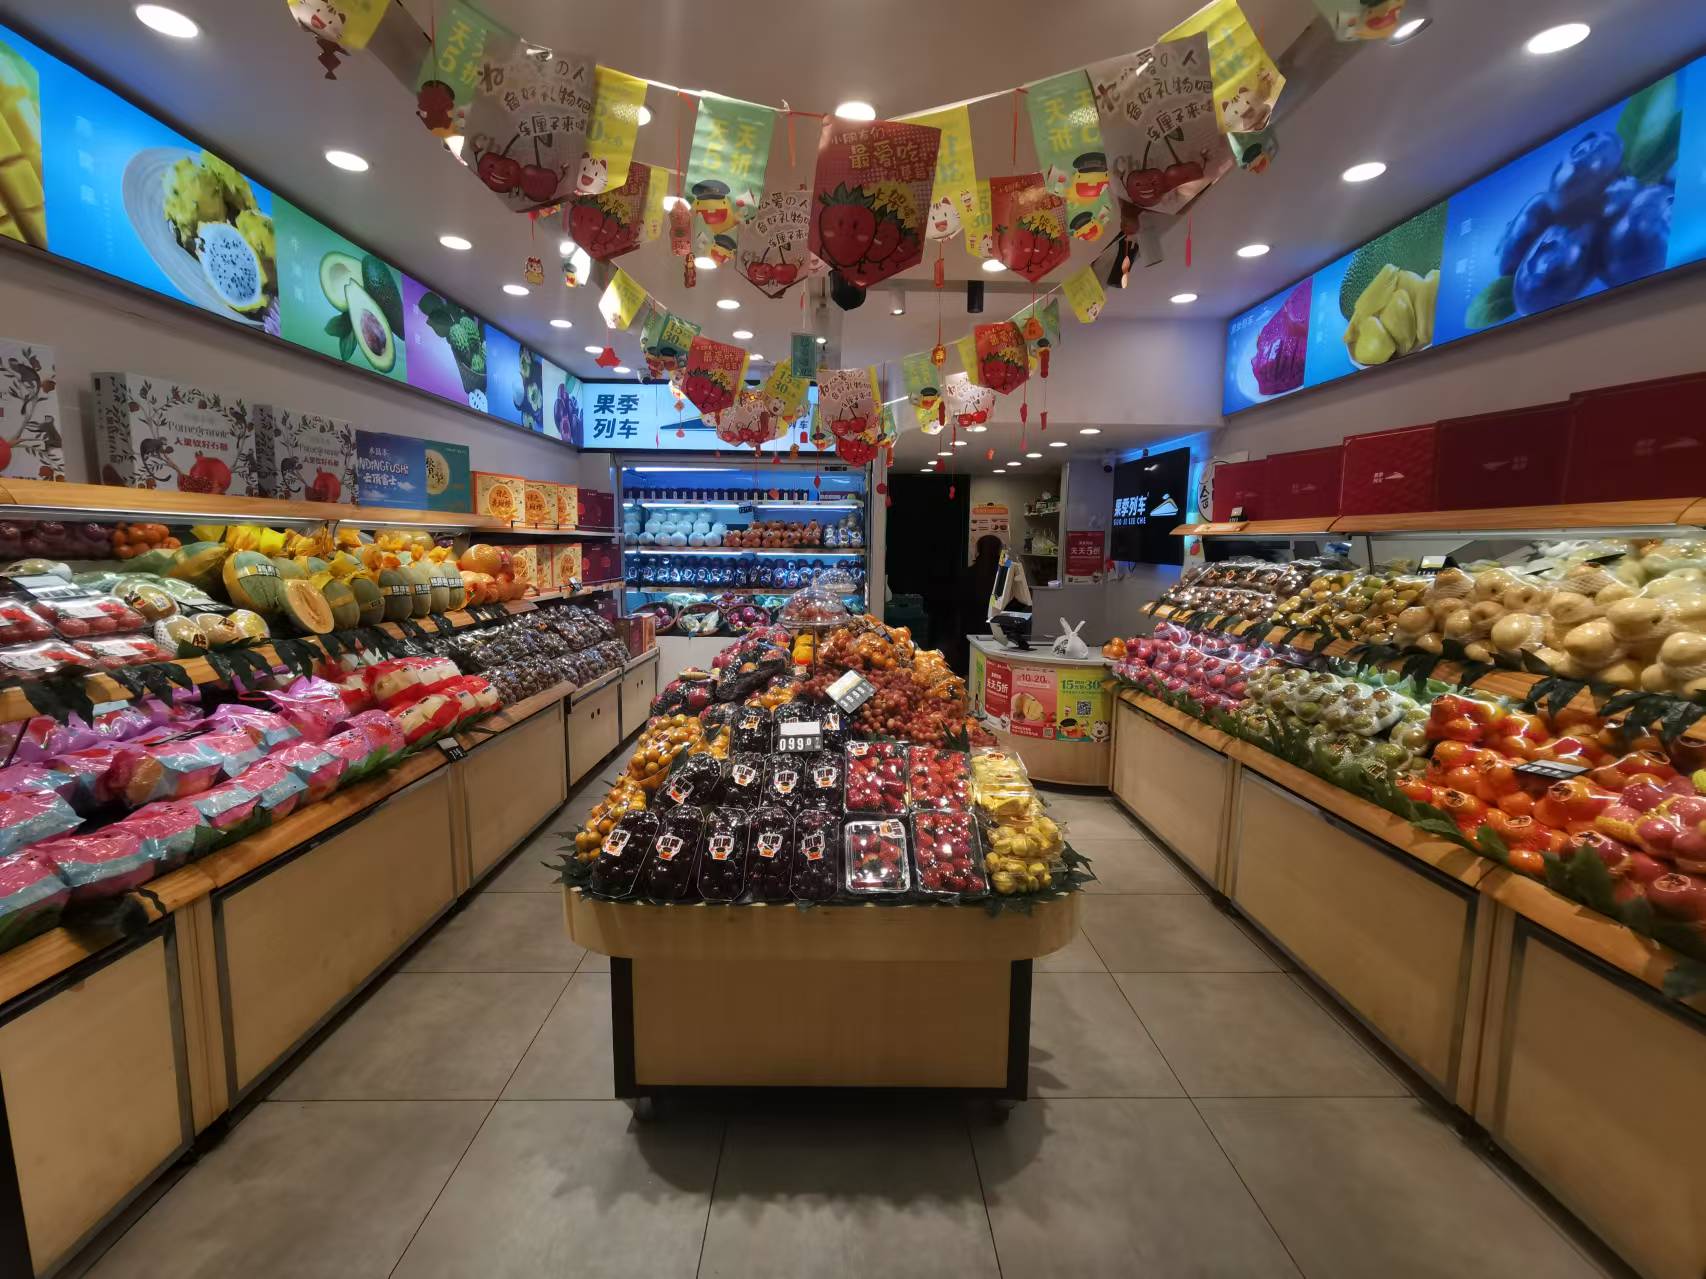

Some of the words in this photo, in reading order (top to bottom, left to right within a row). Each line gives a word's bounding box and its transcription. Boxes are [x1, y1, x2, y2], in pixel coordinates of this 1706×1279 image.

[849, 140, 920, 169] 最爱吃
[593, 393, 640, 415] 果季
[593, 418, 640, 440] 列车
[1114, 495, 1147, 517] 果季列车
[1071, 546, 1100, 556] 天天5折
[986, 678, 1009, 694] 天天5折
